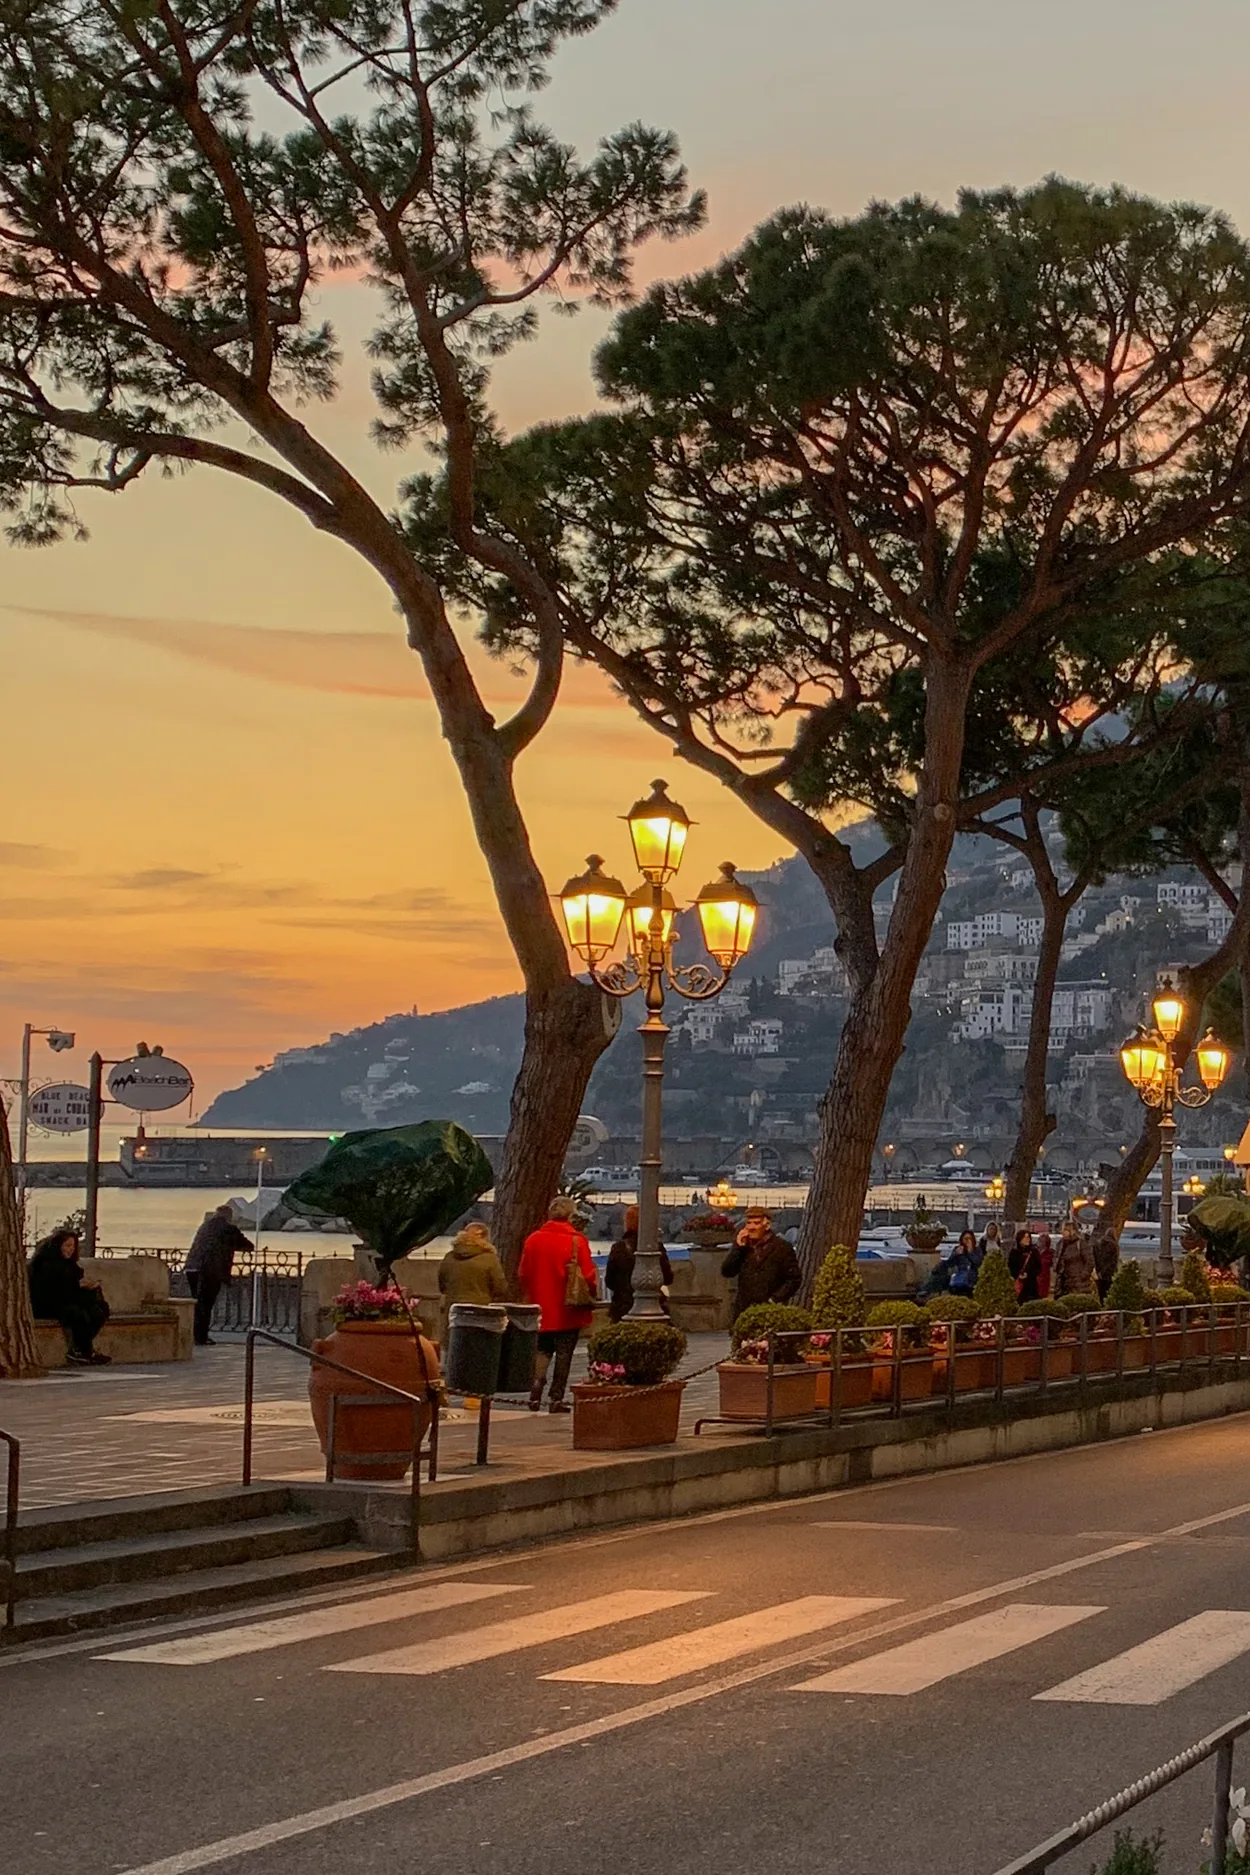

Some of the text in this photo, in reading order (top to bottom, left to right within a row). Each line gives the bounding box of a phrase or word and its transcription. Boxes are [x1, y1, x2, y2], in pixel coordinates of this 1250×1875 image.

[41, 1092, 90, 1101] BLUE BEAC
[40, 1117, 87, 1125] SNACK BA
